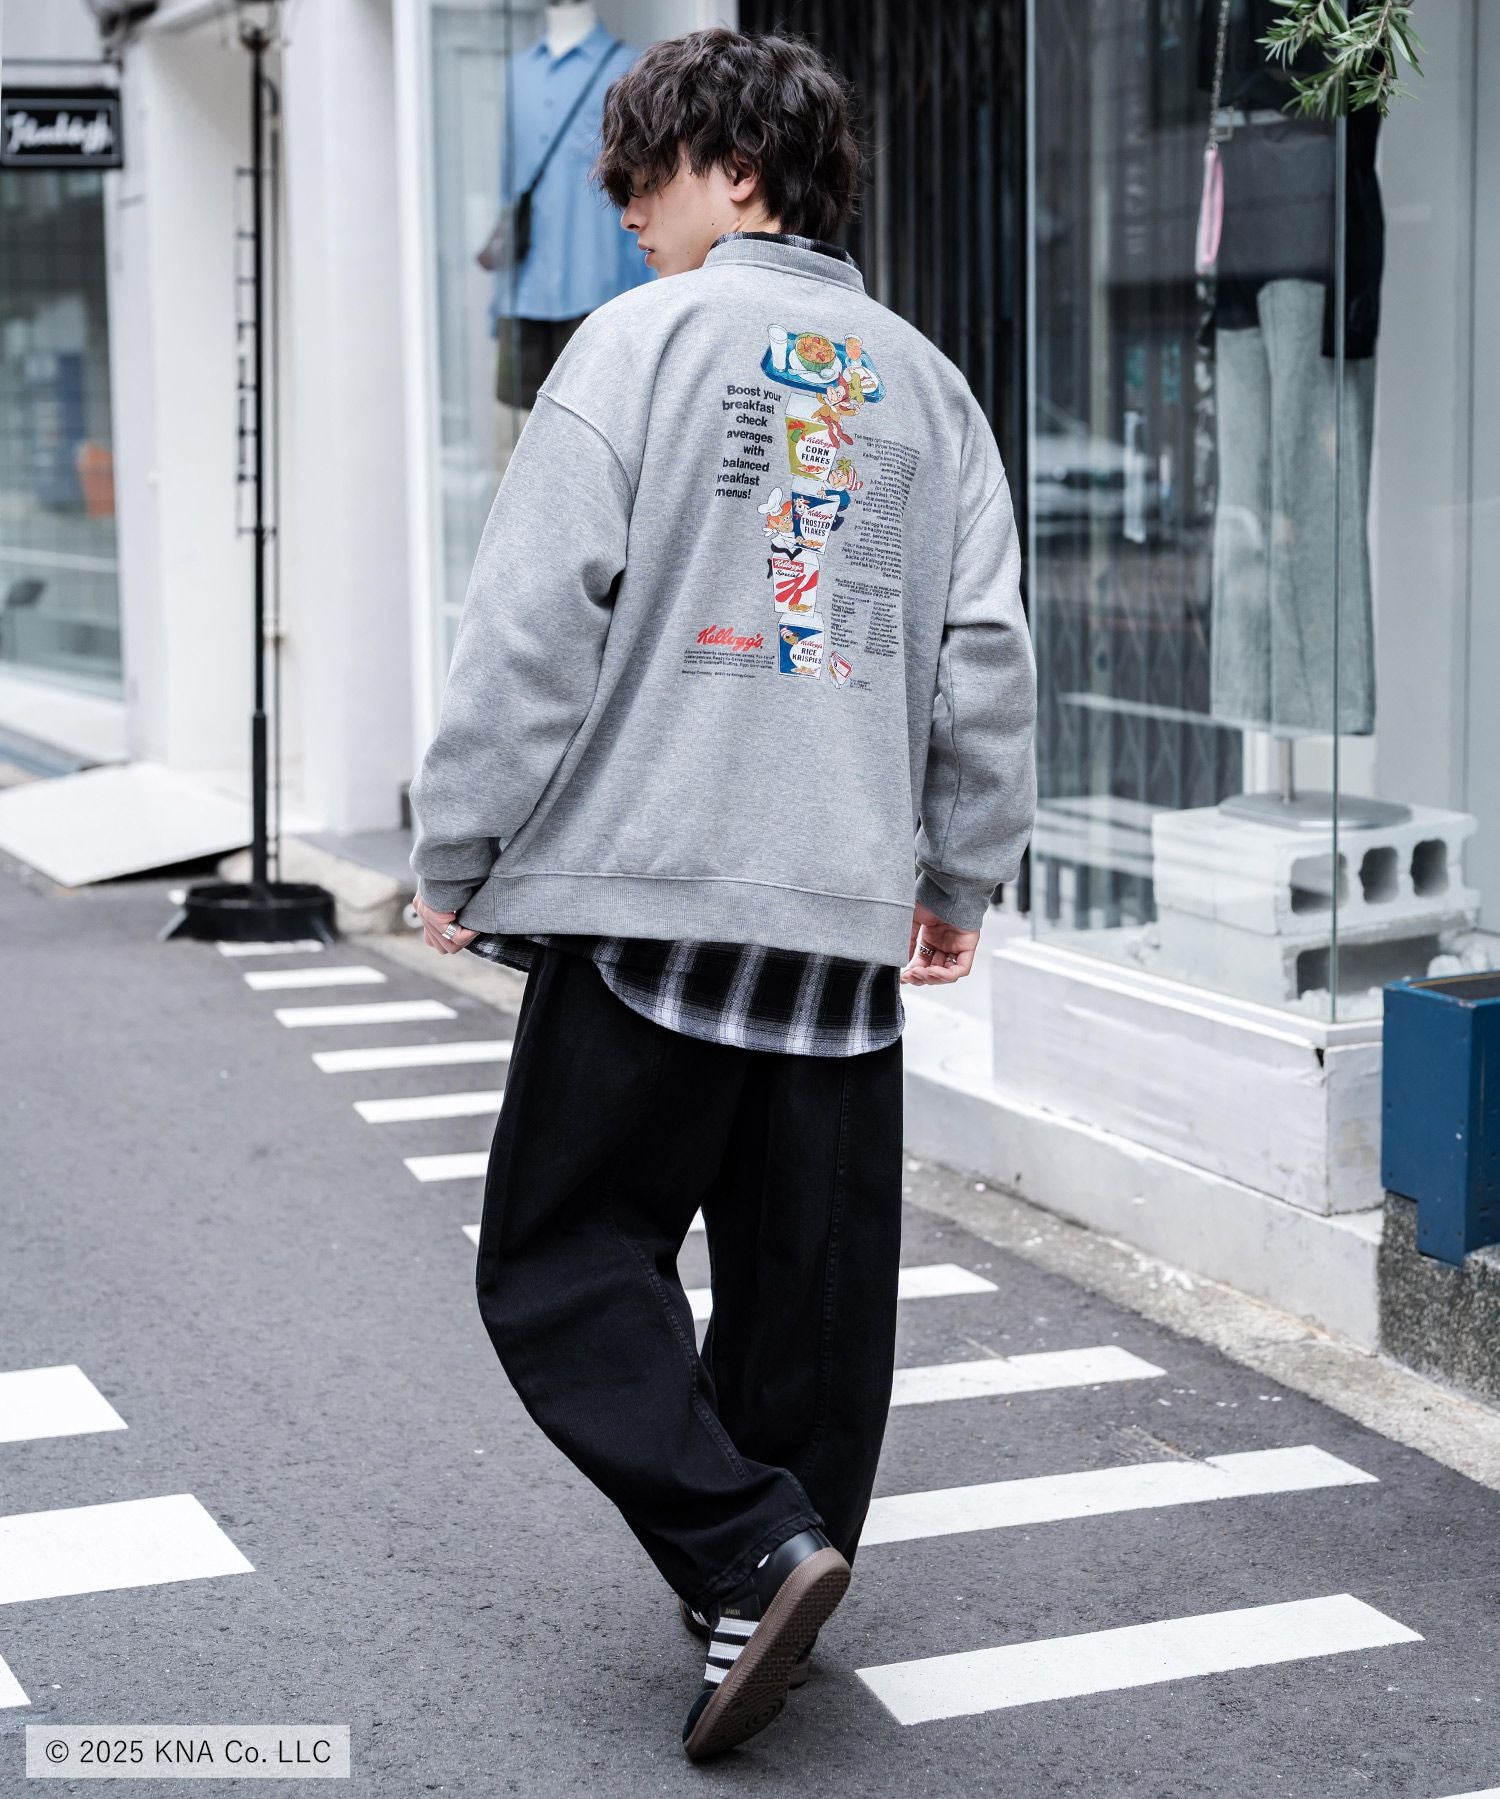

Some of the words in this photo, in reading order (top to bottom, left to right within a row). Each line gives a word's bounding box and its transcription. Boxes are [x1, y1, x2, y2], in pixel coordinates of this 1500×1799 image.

[727, 385, 760, 397] Boost
[763, 389, 782, 402] your
[722, 400, 775, 414] breakfast
[736, 413, 768, 427] check
[727, 430, 773, 443] averages
[743, 444, 765, 456] with
[805, 445, 830, 456] CORN
[722, 457, 770, 472] balanced
[801, 453, 831, 465] FLAKES
[715, 489, 751, 499] menus!
[807, 510, 834, 521] Kellogg's
[801, 517, 831, 530] FROSTED
[804, 526, 826, 537] FLAKES
[776, 570, 800, 578] Special
[775, 570, 819, 606] K
[697, 625, 764, 652] Kellogg's
[801, 647, 817, 657] RICE
[792, 654, 822, 665] KRISPIES
